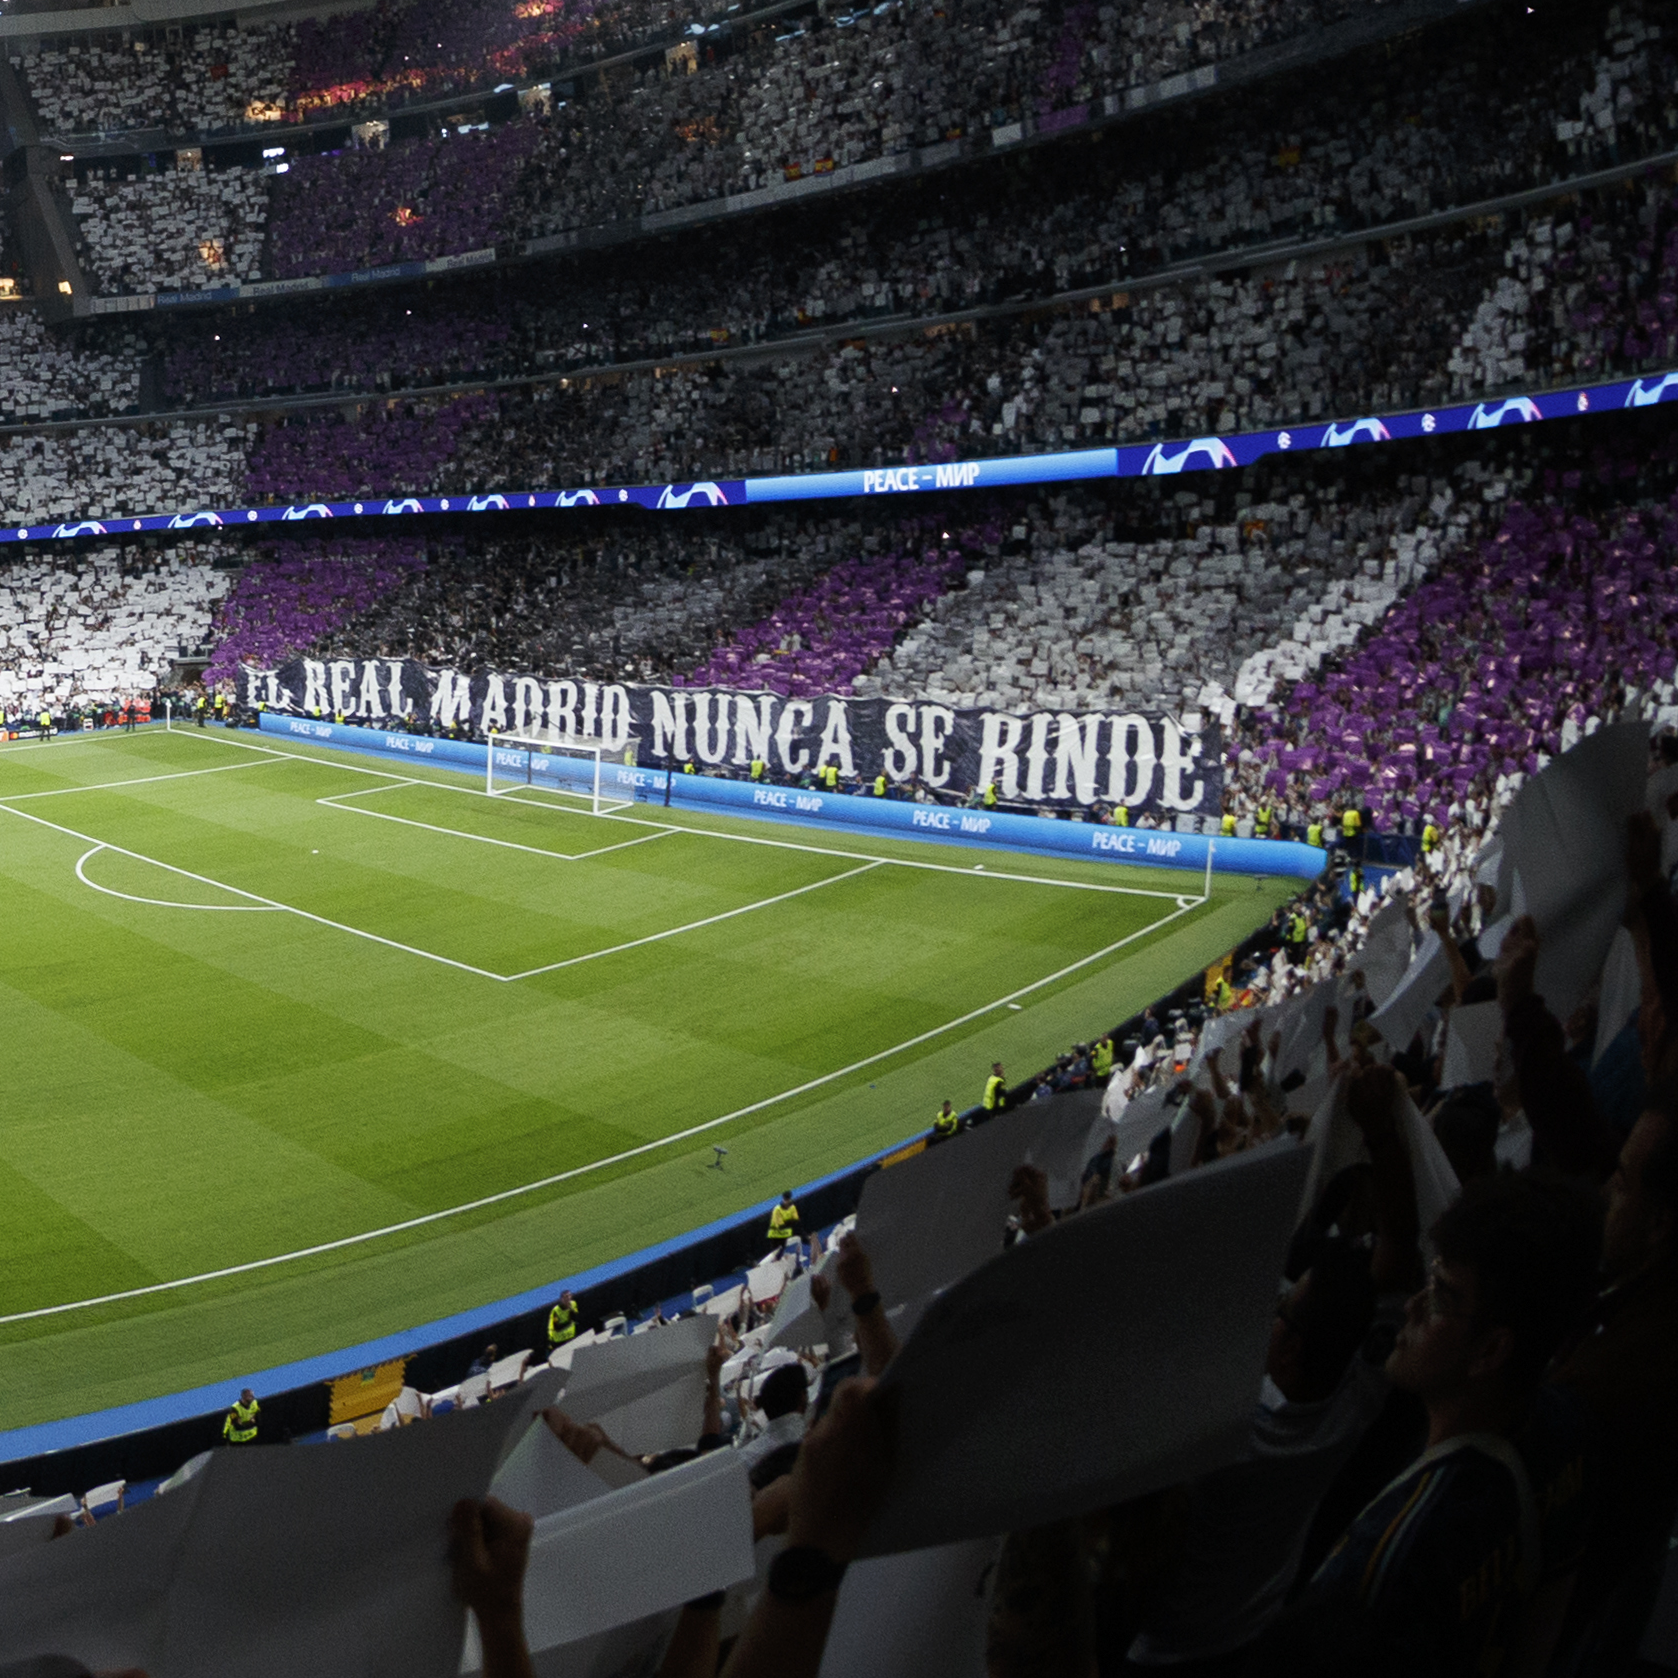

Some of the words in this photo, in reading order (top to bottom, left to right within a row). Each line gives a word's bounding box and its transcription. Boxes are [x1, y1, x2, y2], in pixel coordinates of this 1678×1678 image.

[863, 467, 920, 493] PEACE
[302, 657, 413, 719] REAL
[429, 668, 635, 752] MADRID
[649, 690, 859, 778] NUNCA
[881, 703, 955, 788] SE
[978, 711, 1205, 812] RINDE
[753, 789, 788, 808] PEACE
[912, 810, 951, 830] PEACE
[1091, 831, 1137, 853] PEACE
